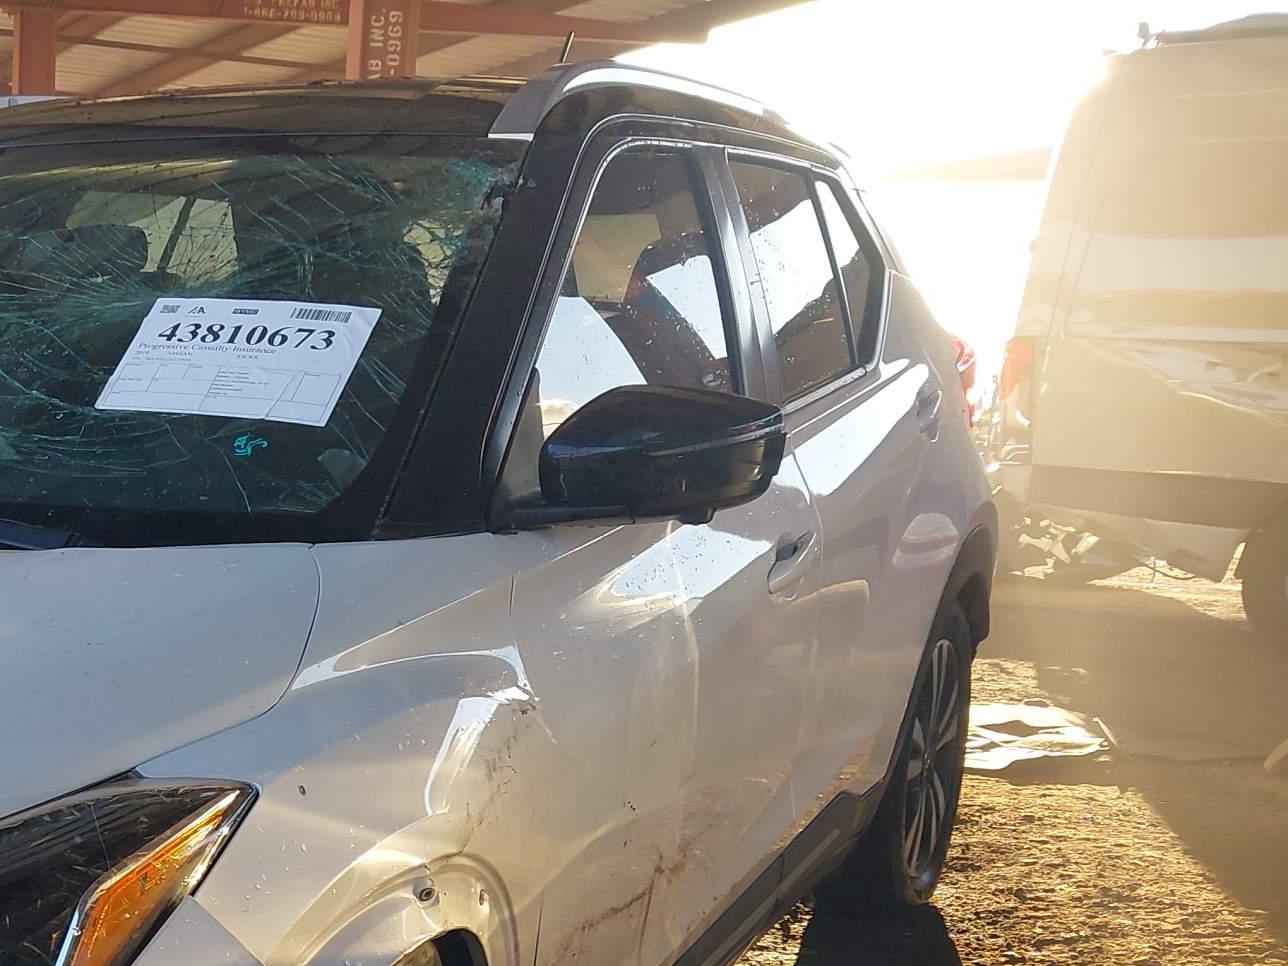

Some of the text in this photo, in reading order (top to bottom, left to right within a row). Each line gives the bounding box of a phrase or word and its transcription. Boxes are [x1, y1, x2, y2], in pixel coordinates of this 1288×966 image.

[369, 8, 385, 47] INC.
[386, 11, 403, 76] -0969
[158, 322, 336, 351] 43810673
[191, 344, 229, 353] Casualty
[231, 345, 277, 354] Insurance
